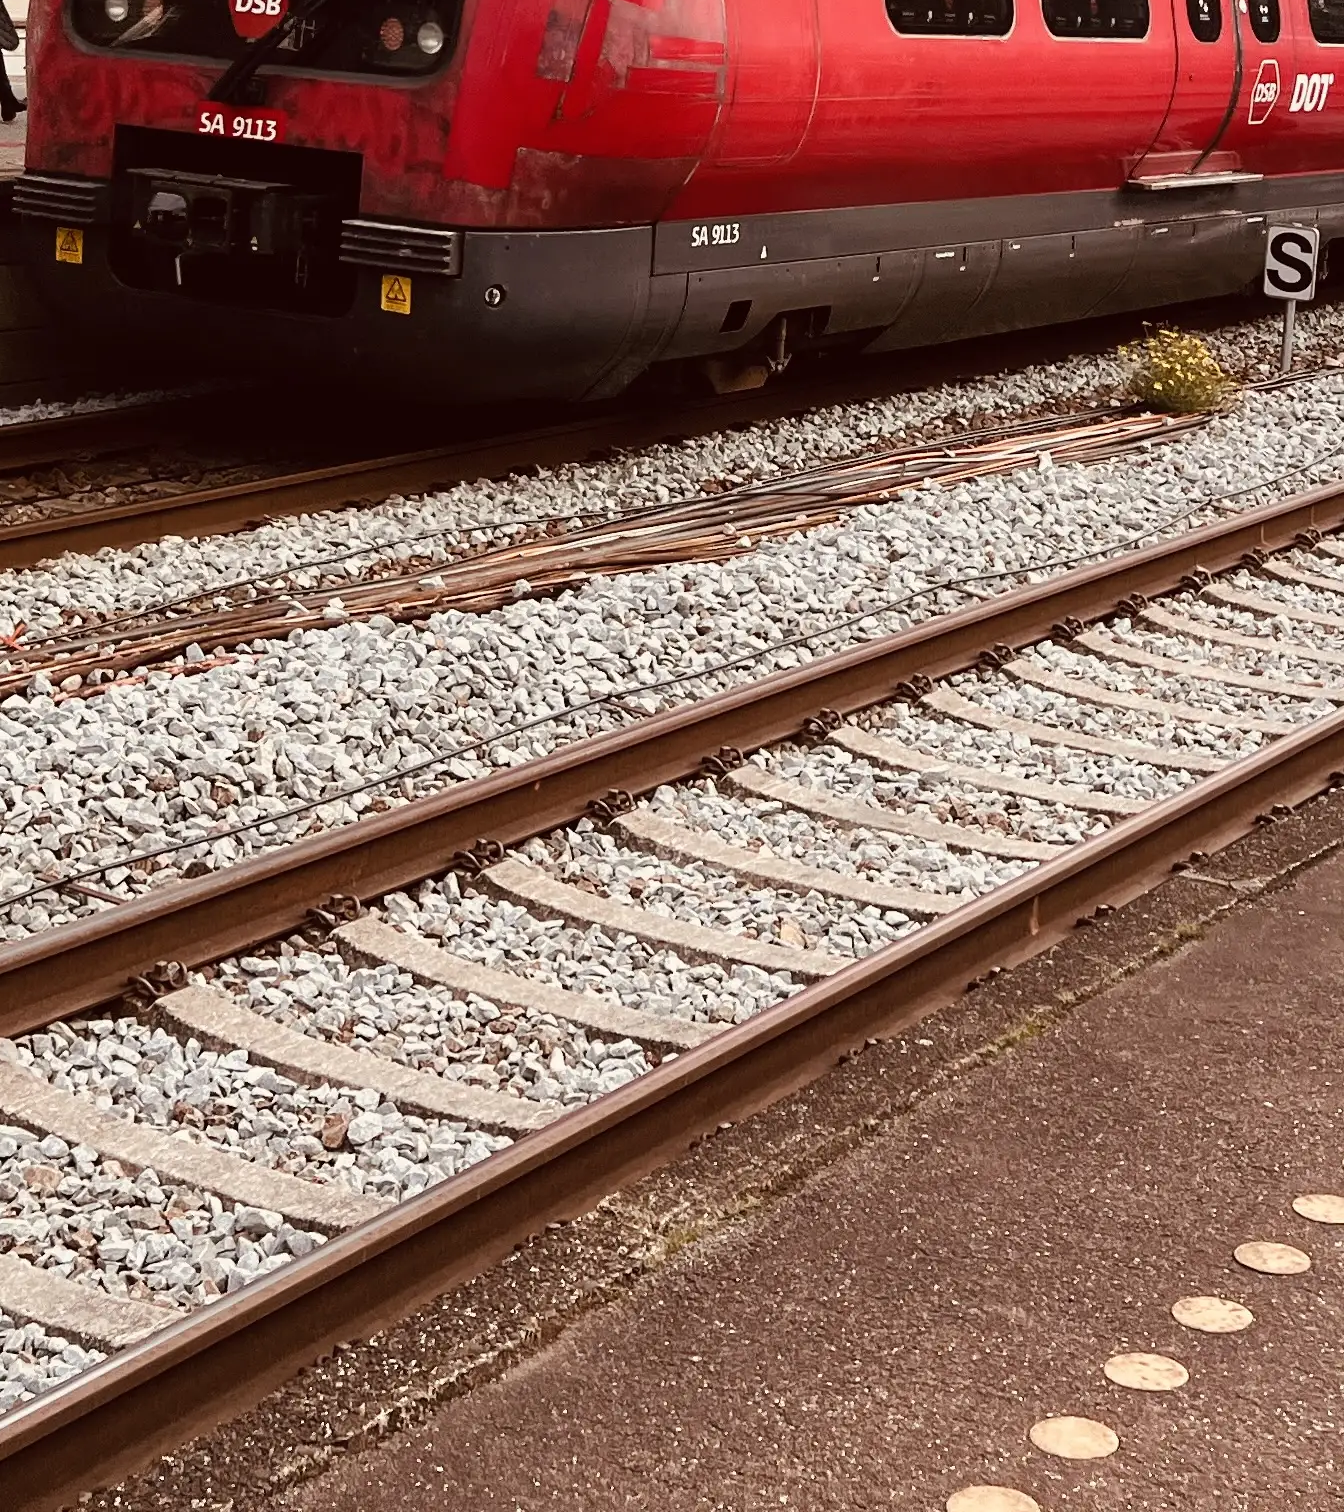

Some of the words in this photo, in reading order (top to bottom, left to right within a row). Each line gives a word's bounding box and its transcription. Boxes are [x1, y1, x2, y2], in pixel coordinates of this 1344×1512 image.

[1254, 82, 1277, 103] DSB
[198, 111, 225, 135] SA
[232, 115, 278, 142] 9113
[691, 225, 709, 247] SA
[711, 223, 740, 245] 9113
[1266, 232, 1314, 293] S
